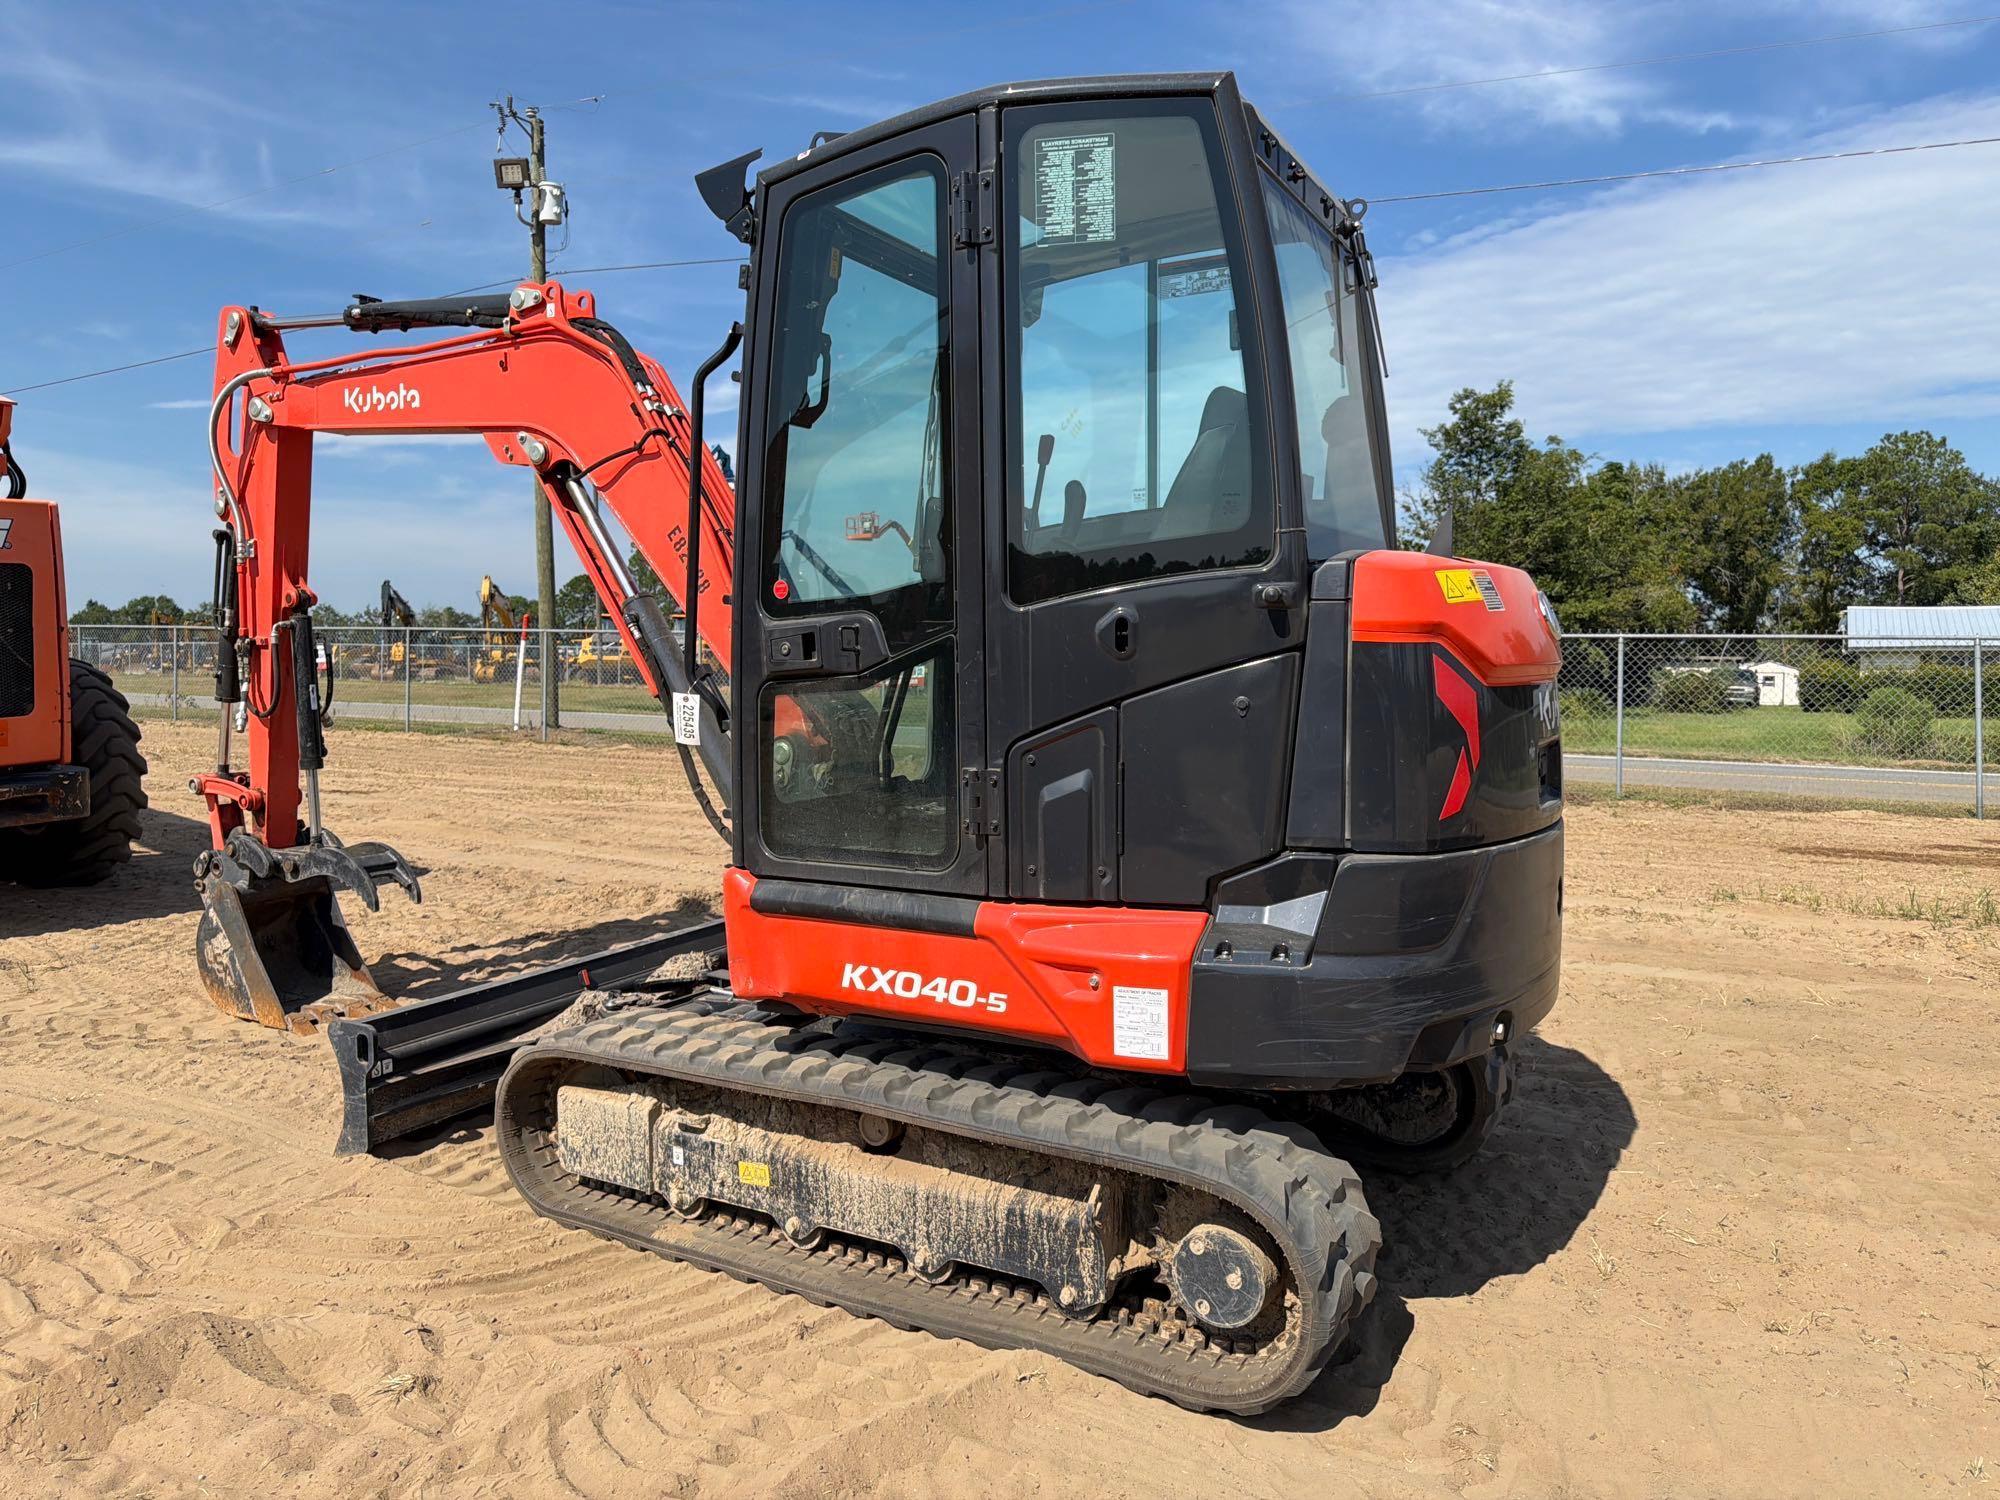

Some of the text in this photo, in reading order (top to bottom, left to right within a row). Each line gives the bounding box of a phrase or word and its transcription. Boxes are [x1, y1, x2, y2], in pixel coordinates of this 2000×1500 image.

[343, 382, 421, 414] Kubota
[682, 705, 695, 740] 225435
[841, 963, 1008, 1014] KX040-5
